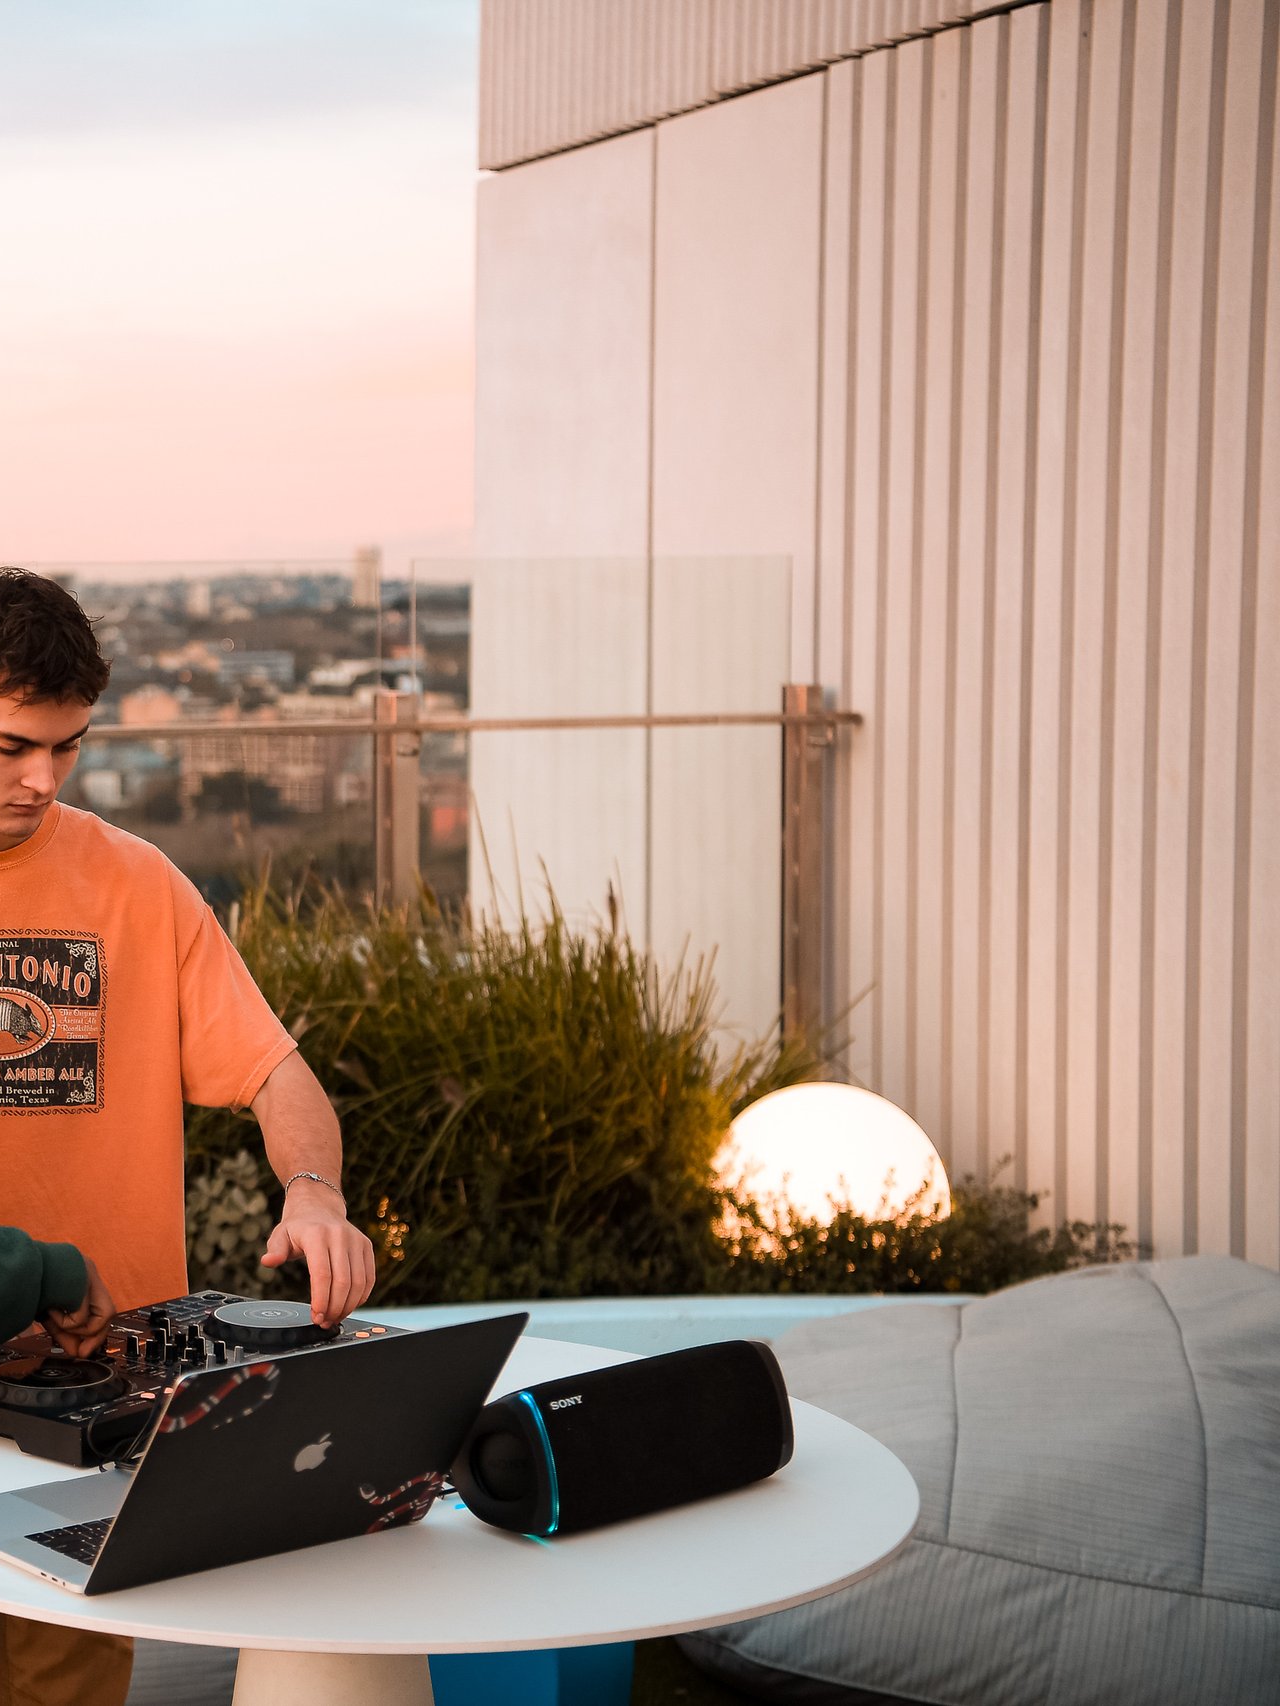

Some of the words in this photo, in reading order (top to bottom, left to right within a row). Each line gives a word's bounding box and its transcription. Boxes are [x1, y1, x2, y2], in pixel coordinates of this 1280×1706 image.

[4, 1067, 55, 1082] AMBER
[58, 1067, 85, 1081] ALE
[6, 1086, 43, 1095] Brewed
[45, 1086, 55, 1094] in
[19, 1095, 50, 1104] Texas
[550, 1395, 583, 1411] SONY
